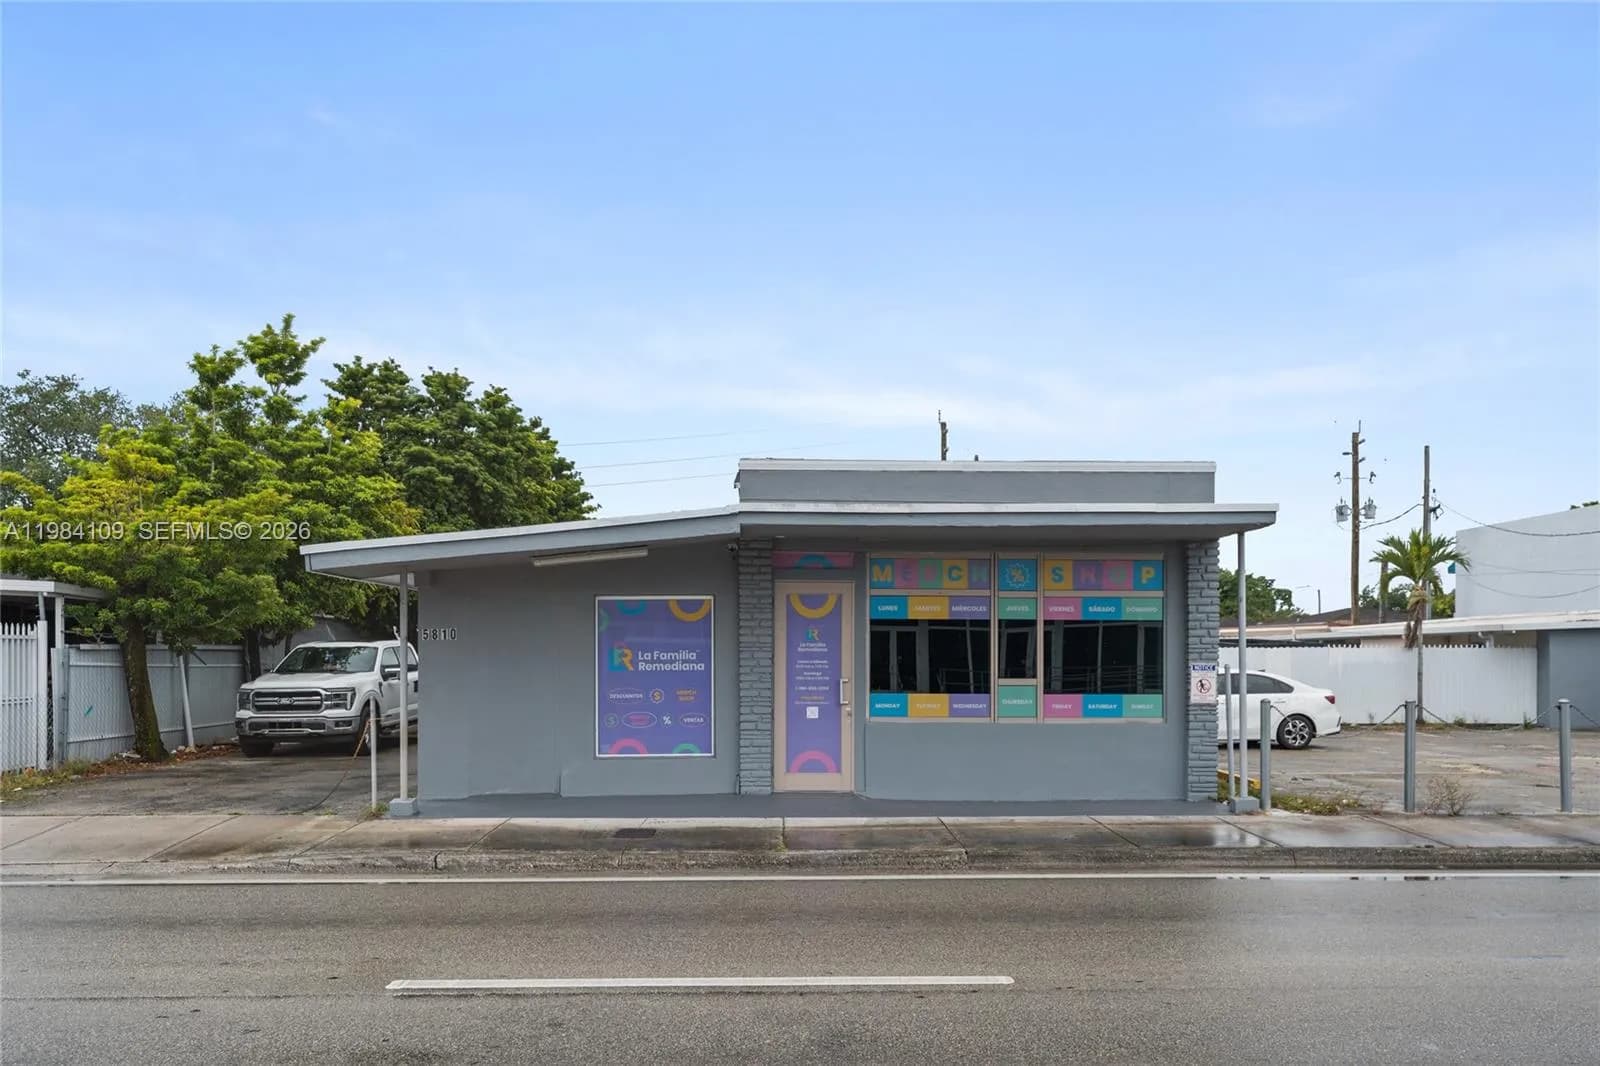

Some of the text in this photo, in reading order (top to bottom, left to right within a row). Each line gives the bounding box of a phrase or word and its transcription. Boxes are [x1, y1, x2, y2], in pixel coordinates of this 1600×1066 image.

[422, 628, 457, 640] 5810
[638, 649, 697, 660] La Familia
[638, 661, 705, 671] Remediana
